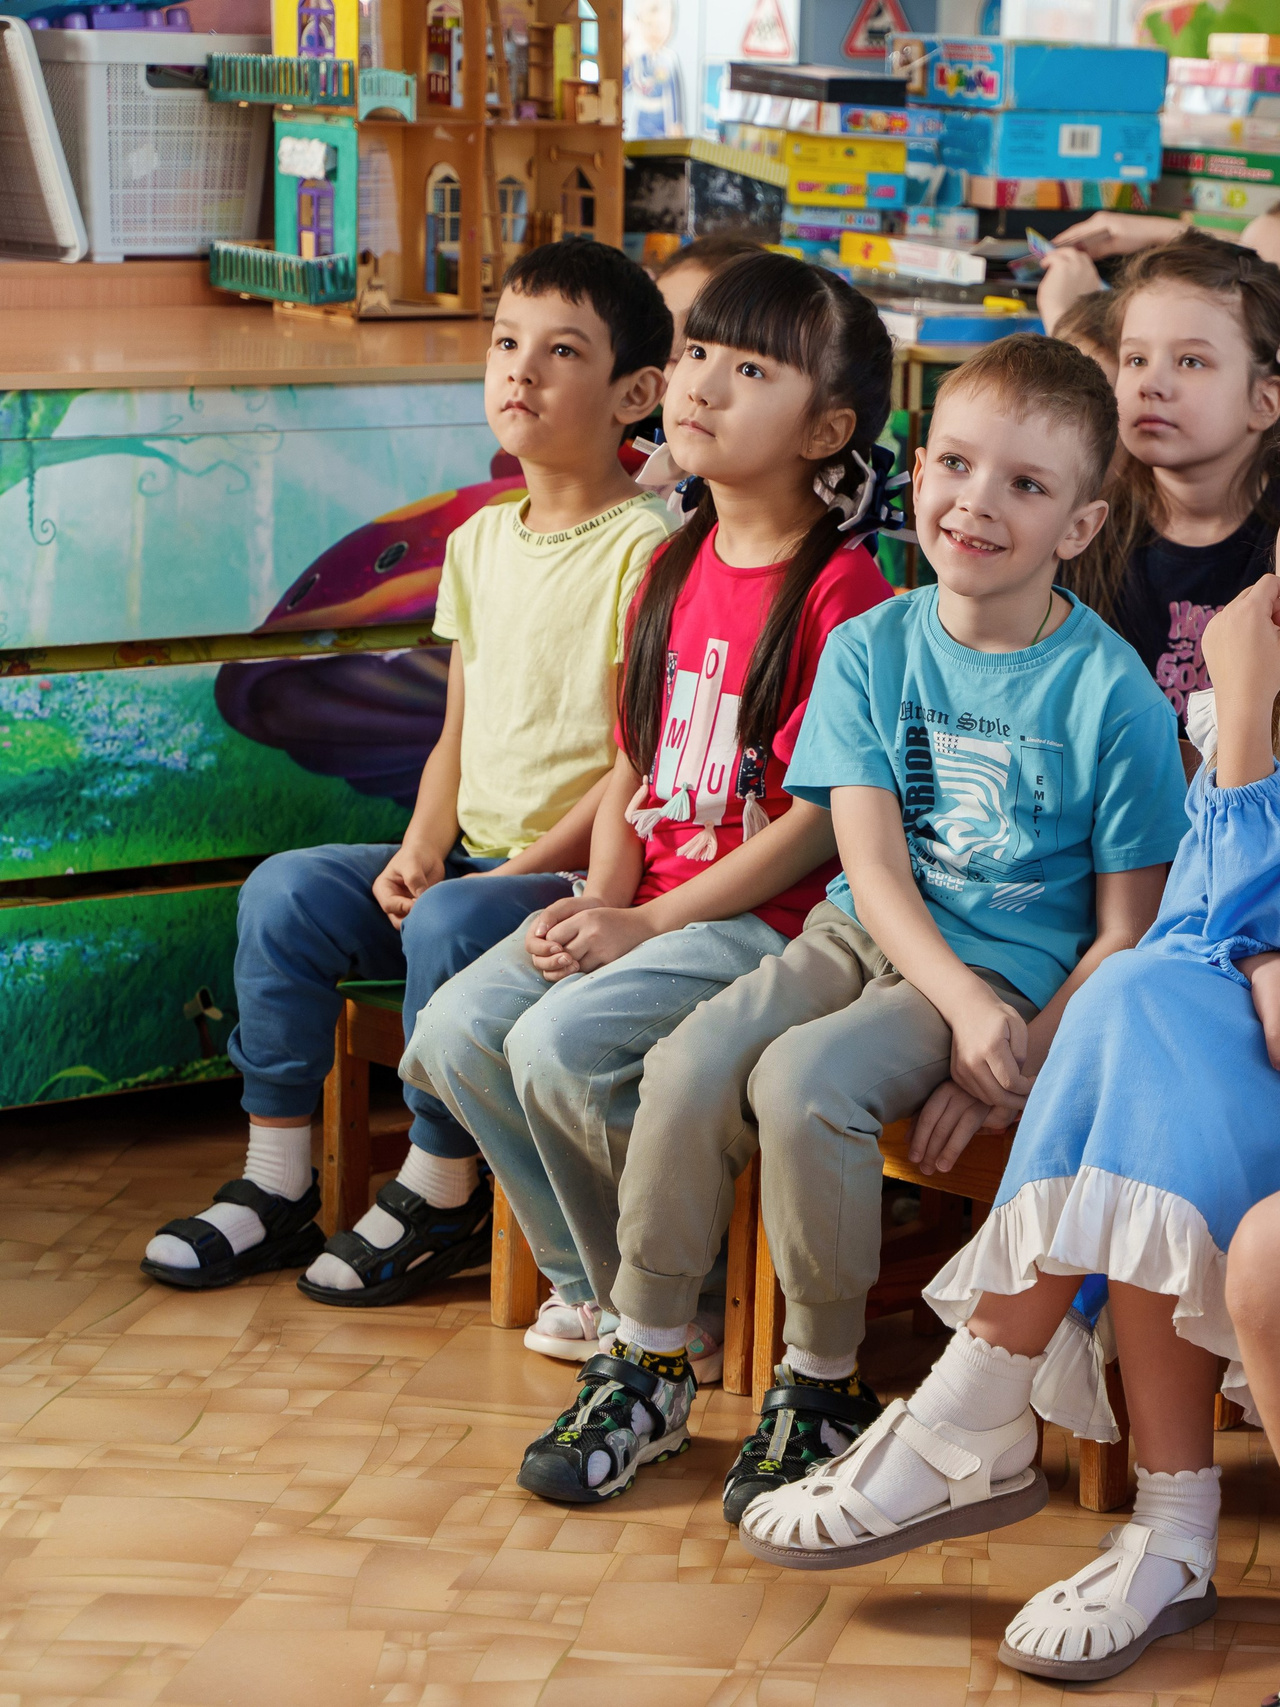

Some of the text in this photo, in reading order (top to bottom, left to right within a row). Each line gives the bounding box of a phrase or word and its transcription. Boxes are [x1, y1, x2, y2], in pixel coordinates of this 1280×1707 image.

[547, 533, 572, 545] COOL
[956, 712, 1011, 742] Style
[1026, 736, 1046, 744] Limited
[904, 725, 935, 838] ERIOR
[1033, 775, 1045, 838] EMPTY
